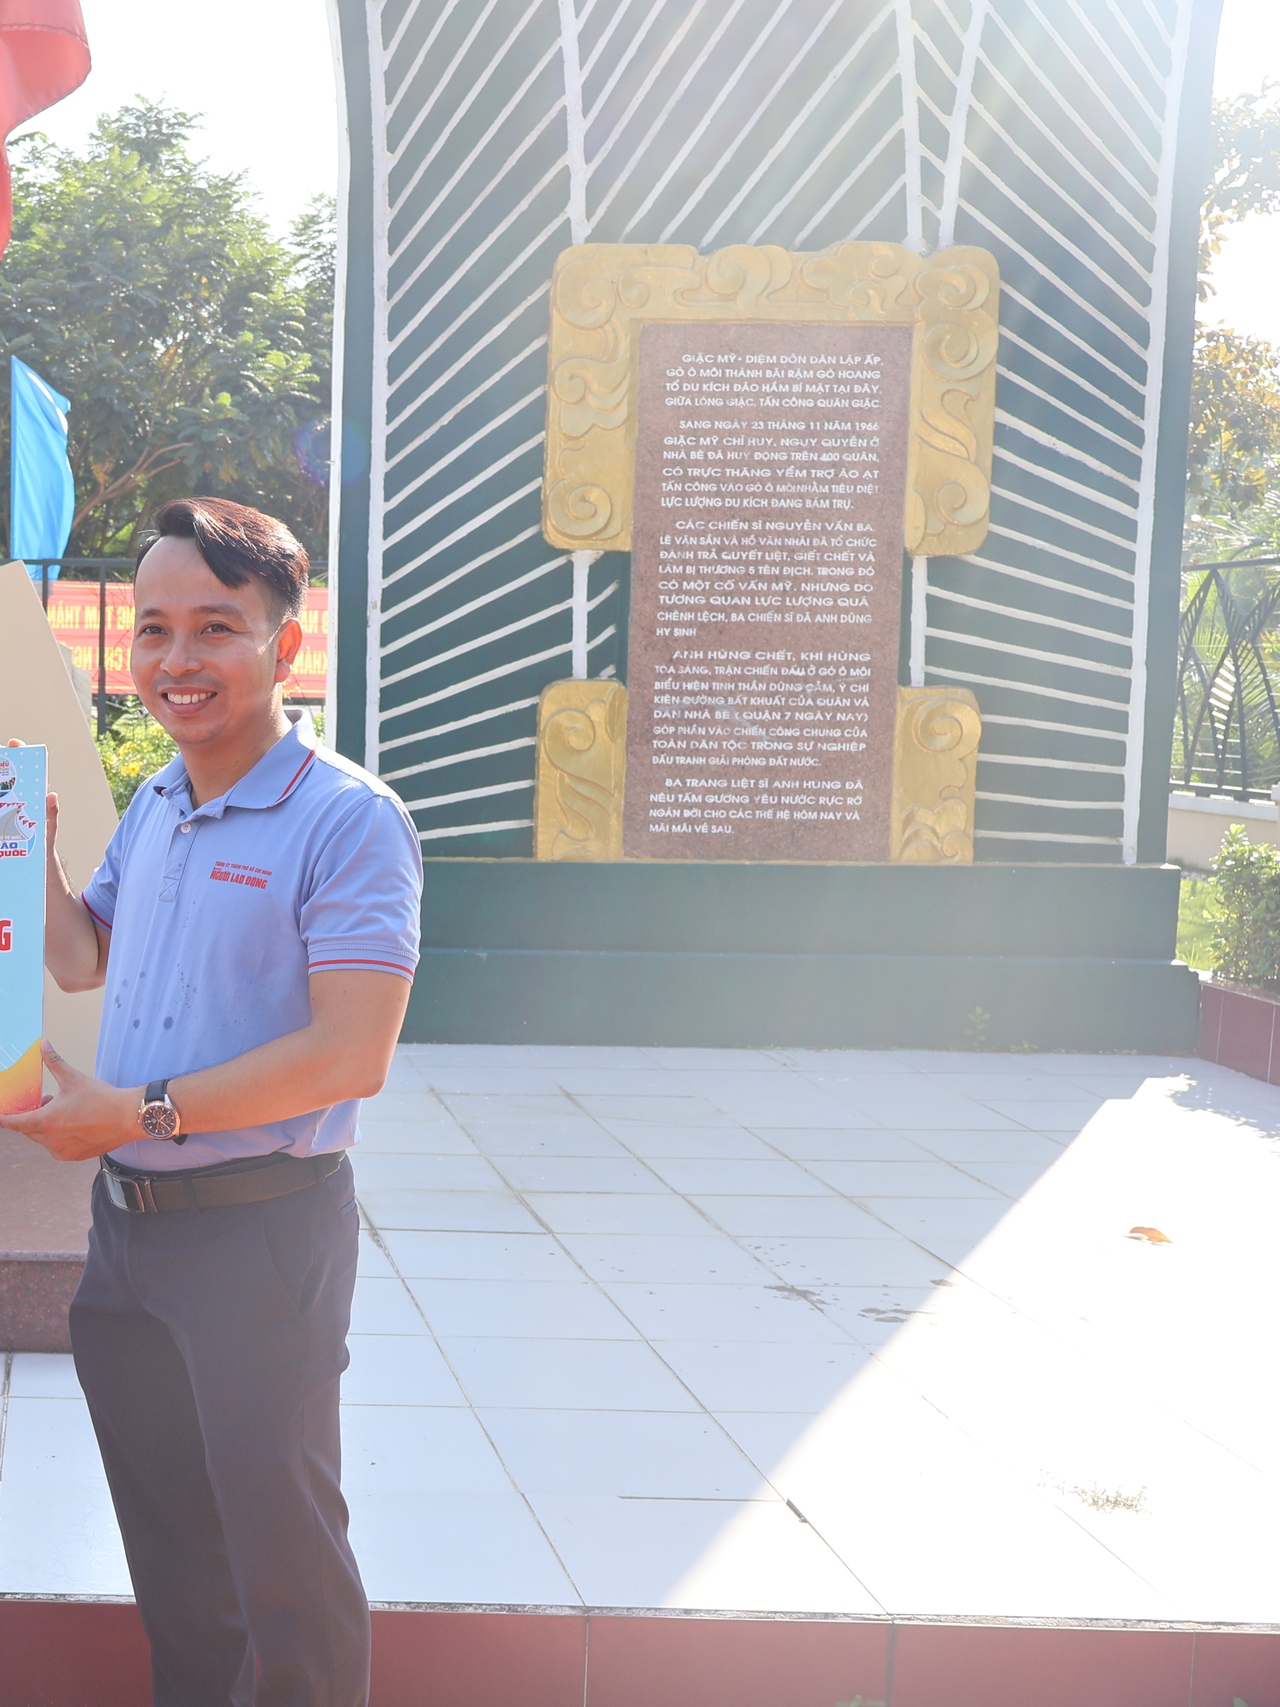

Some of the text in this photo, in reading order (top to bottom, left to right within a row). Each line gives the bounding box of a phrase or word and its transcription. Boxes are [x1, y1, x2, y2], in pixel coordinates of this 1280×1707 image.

[682, 353, 861, 365] GIẶC DIỆM LẬP
[838, 370, 881, 379] HOANG
[683, 383, 699, 391] DU
[782, 397, 814, 407] CÔNG
[752, 421, 879, 431] 23 11 NĂM 1966
[663, 435, 696, 446] GIẶC
[687, 467, 721, 477] TRỰC
[661, 496, 682, 508] LỰC
[685, 497, 722, 508] LƯỢNG
[743, 497, 768, 508] KÍCH
[771, 498, 803, 508] ĐANG
[699, 565, 745, 574] THƯƠNG
[749, 566, 755, 574] 5
[758, 565, 779, 575] TÊN
[683, 580, 710, 591] MỘT
[659, 594, 834, 607] TƯƠNG QUAN LỰC LƯỢNG
[731, 612, 745, 622] BA
[814, 613, 837, 623] ANH
[656, 628, 696, 636] HY SINH
[672, 650, 703, 659] ANH
[742, 710, 791, 721] QUẬN 7
[803, 728, 842, 737] CHUNG
[675, 756, 706, 765] TRANH
[665, 778, 799, 789] BA TRANG LIỆT ANH
[705, 794, 750, 804] GƯƠNG
[704, 809, 727, 818] CHO
[793, 810, 817, 819] HÔM
[820, 811, 842, 820] NAY
[711, 825, 734, 833] SAU.
[230, 873, 245, 884] LAO
[245, 876, 268, 889] ĐỘNG
